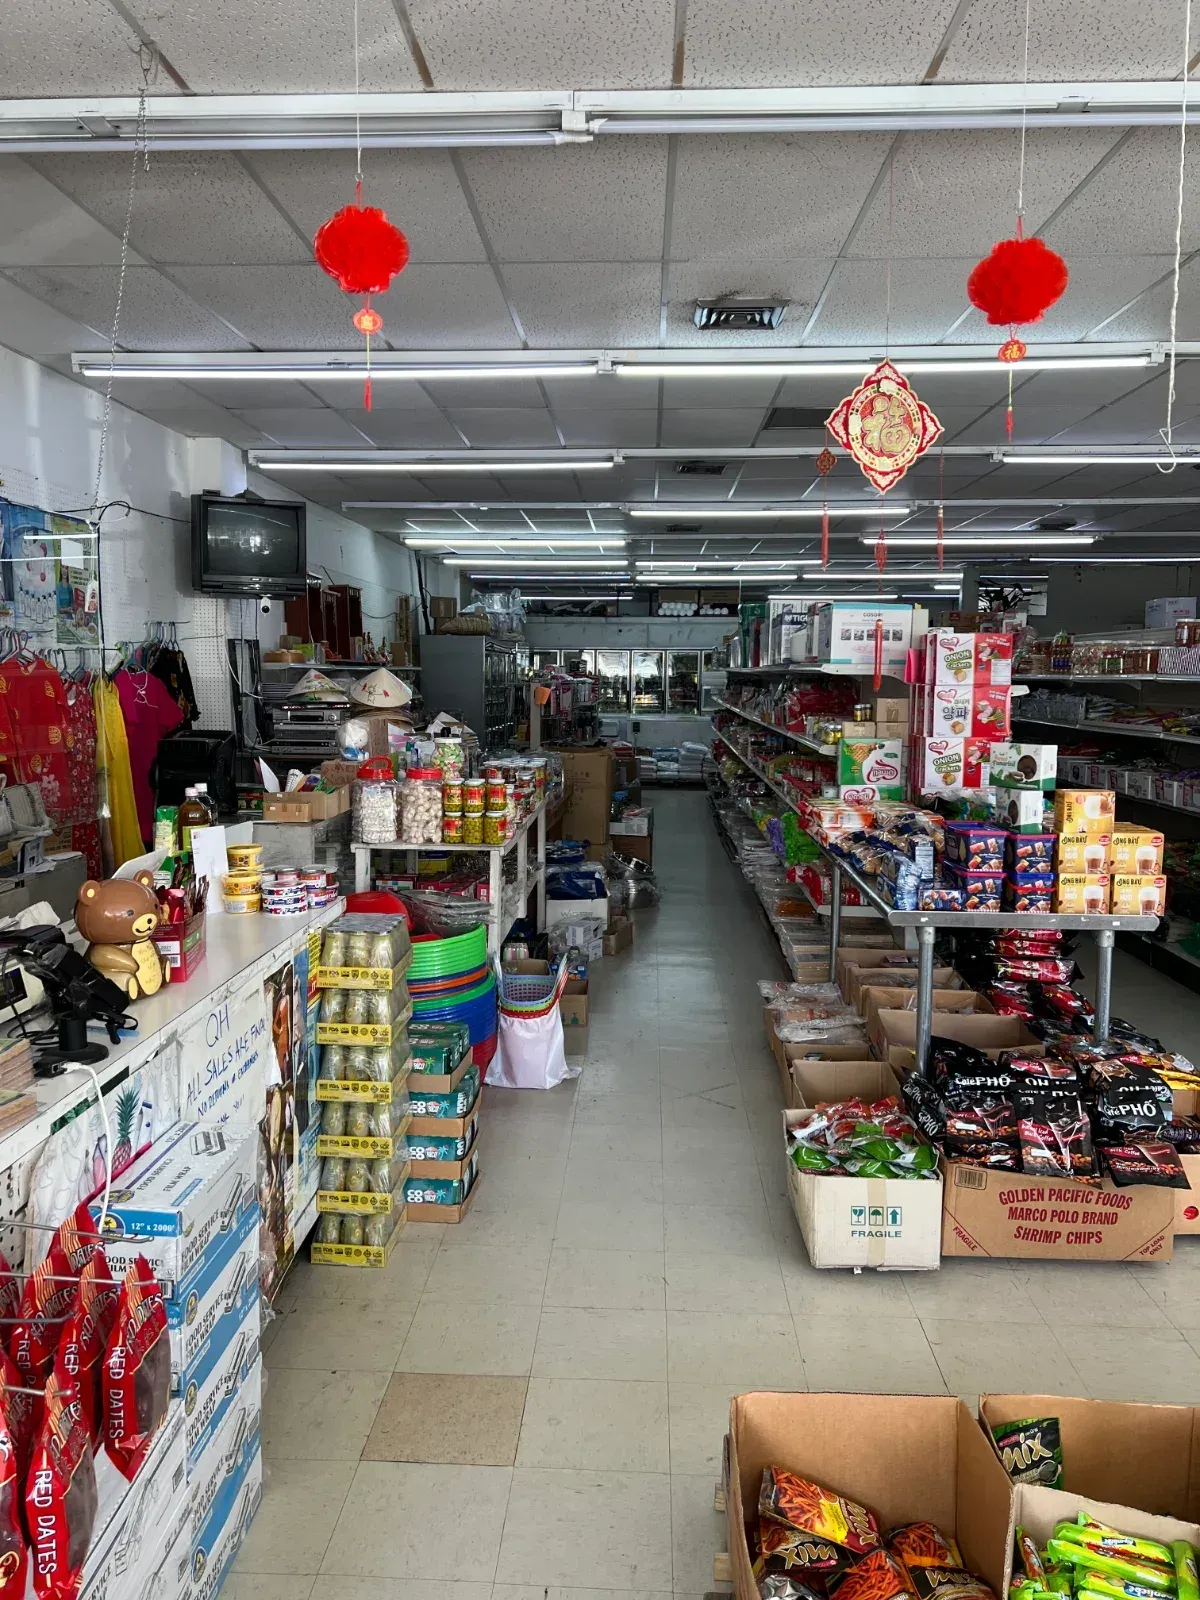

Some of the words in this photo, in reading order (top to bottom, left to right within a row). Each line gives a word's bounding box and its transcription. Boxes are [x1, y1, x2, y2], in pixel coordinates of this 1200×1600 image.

[862, 396, 912, 453] 福
[945, 651, 970, 661] ONION
[934, 754, 960, 765] ONION
[204, 1045, 233, 1086] SALES
[137, 1173, 155, 1191] FOOD
[154, 1158, 174, 1176] SERVICE
[177, 1166, 192, 1182] WRAP
[998, 1188, 1045, 1206] GOLDEN
[1048, 1188, 1093, 1204] PACIFIC
[1094, 1192, 1133, 1210] FOODS
[1008, 1207, 1048, 1222] MARCO
[1050, 1210, 1079, 1224] POLO
[1081, 1211, 1118, 1226] BRAND
[181, 1234, 198, 1262] FOOD
[198, 1208, 220, 1241] SERVICE
[851, 1230, 902, 1238] FRAGILE
[953, 1226, 978, 1252] FRAGILE
[1013, 1226, 1062, 1244] SHRIMP
[1066, 1230, 1103, 1244] CHIPS
[1139, 1244, 1151, 1256] TOP
[1149, 1235, 1165, 1250] LOAD
[105, 1256, 126, 1264] OOD
[1149, 1244, 1164, 1256] ONLY
[185, 1321, 202, 1348] FOOD
[202, 1290, 224, 1326] SERVICE
[200, 1313, 216, 1341] WRAP
[65, 1343, 79, 1375] RED
[109, 1346, 126, 1380] RED
[109, 1389, 124, 1439] DATES
[186, 1410, 202, 1437] FOOD
[203, 1374, 224, 1411] SERVICE
[1003, 1433, 1053, 1472] mix
[35, 1470, 53, 1508] RED
[37, 1515, 57, 1574] DATES
